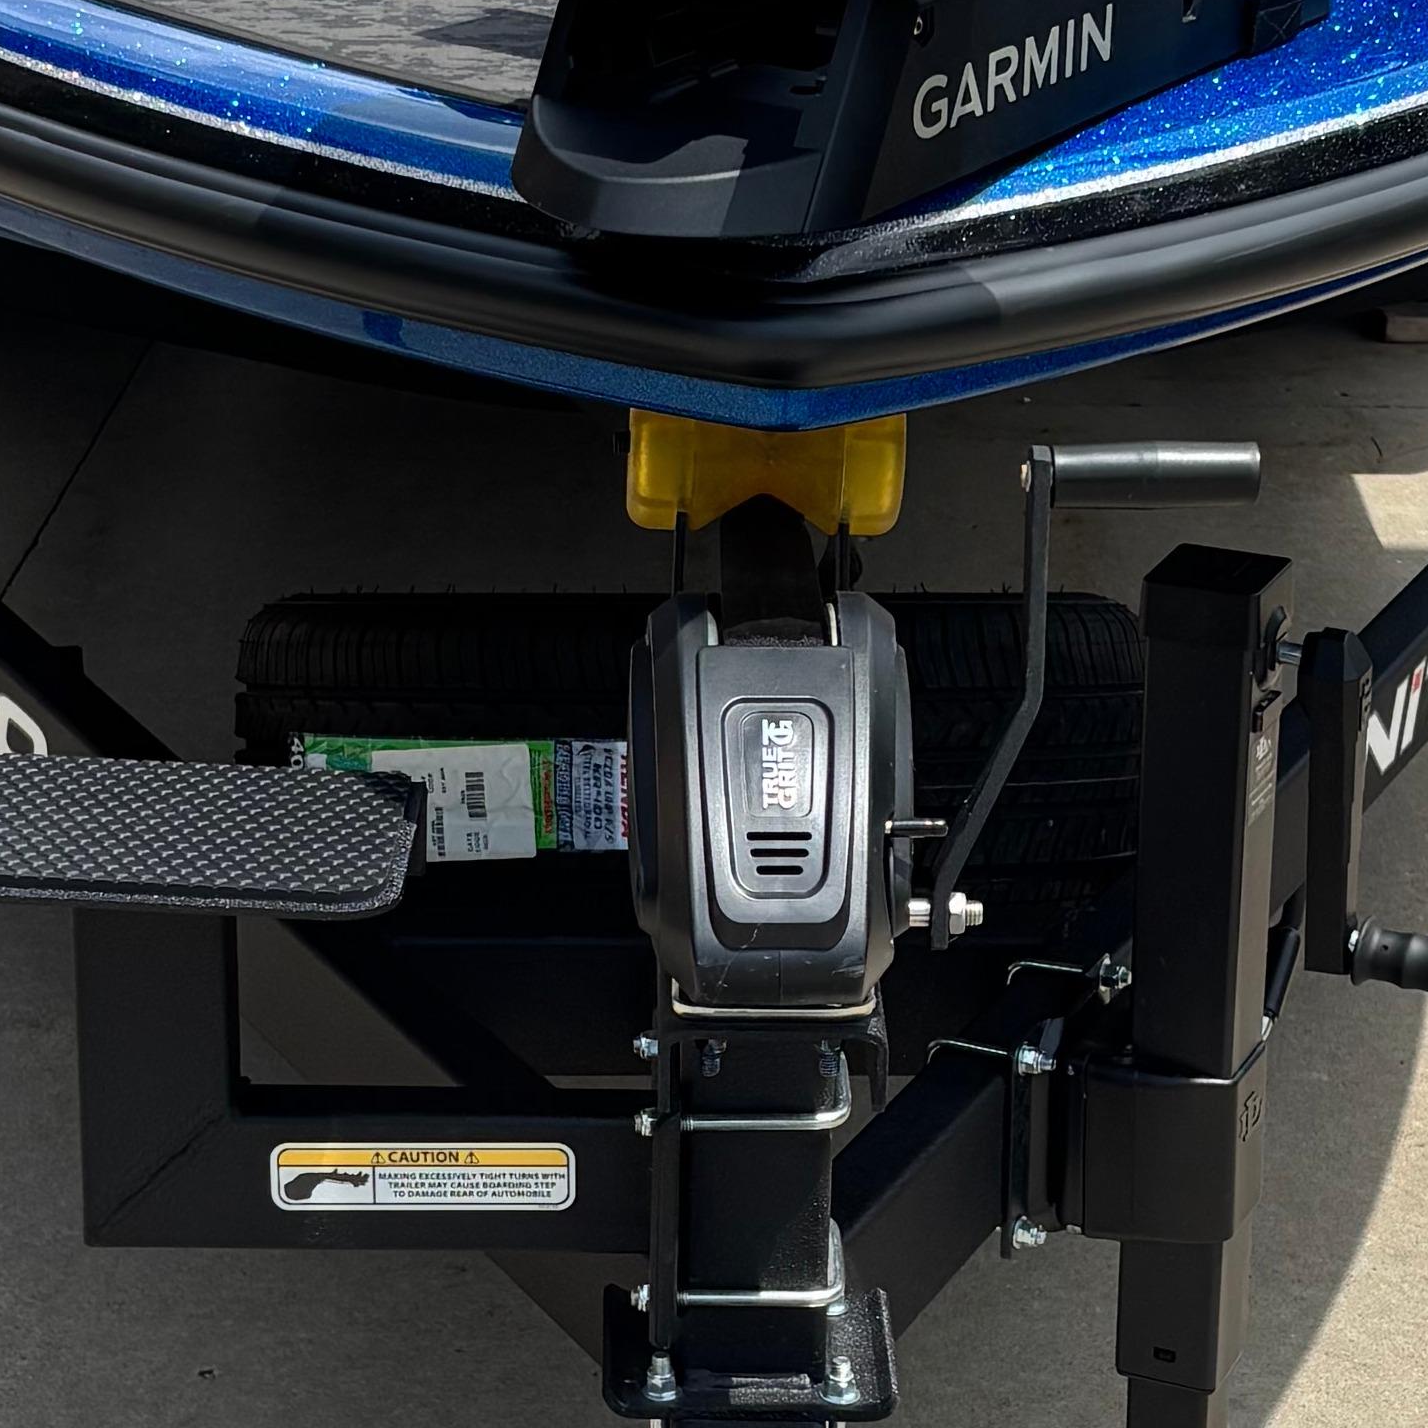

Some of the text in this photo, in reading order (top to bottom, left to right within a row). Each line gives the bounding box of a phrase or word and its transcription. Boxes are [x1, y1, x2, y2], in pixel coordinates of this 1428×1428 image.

[913, 3, 1113, 139] GARMIN
[762, 747, 778, 809] TRUE
[778, 747, 797, 810] GRIT
[388, 1151, 459, 1163] CAUTION
[379, 1172, 417, 1180] MAKING
[419, 1172, 477, 1180] EXCESSIVELY
[388, 1181, 426, 1189] TRAILER
[428, 1181, 447, 1189] MAY
[450, 1181, 480, 1189] CAUSE
[393, 1190, 406, 1198] TO
[408, 1190, 448, 1198] DAMAGE
[450, 1190, 474, 1198] REAR
[491, 1190, 552, 1198] AUTOMOBILE
